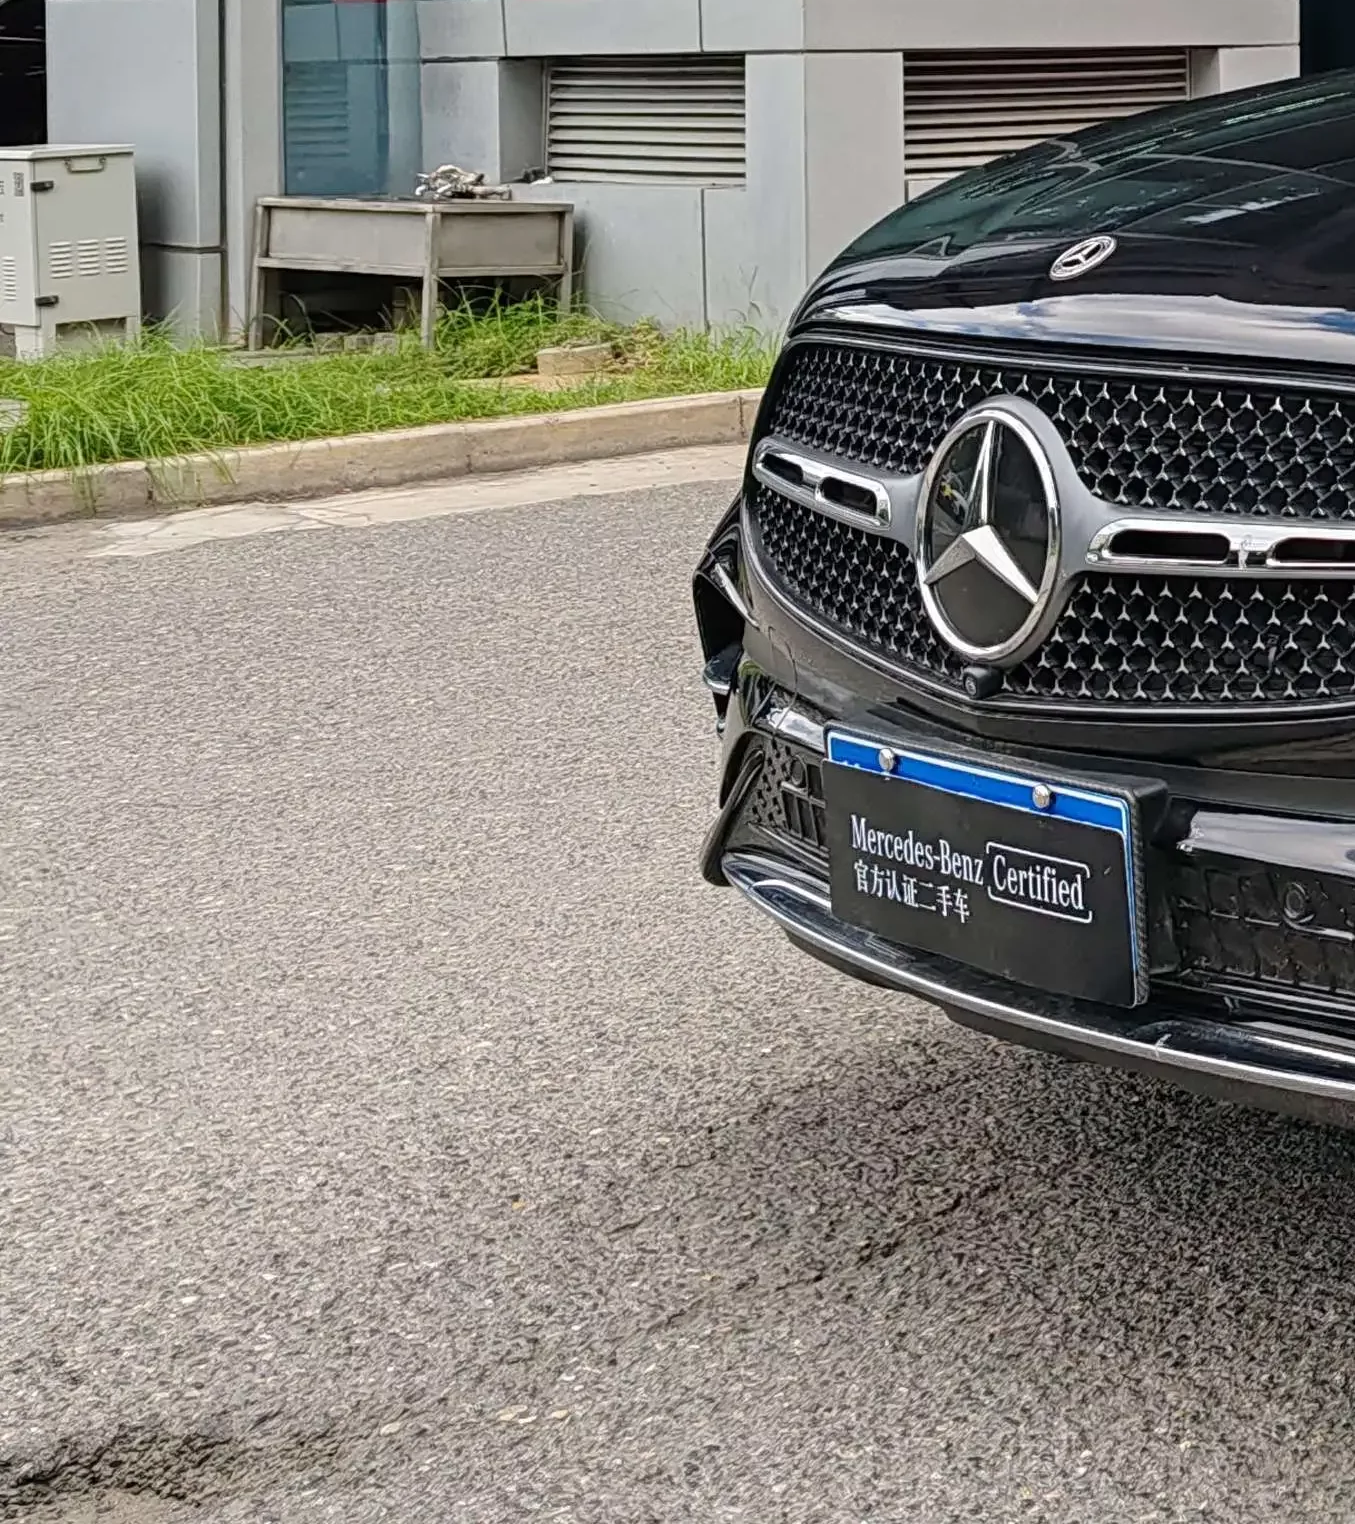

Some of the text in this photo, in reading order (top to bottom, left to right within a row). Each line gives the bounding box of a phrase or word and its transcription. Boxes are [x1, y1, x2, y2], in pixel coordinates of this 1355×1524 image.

[850, 814, 1085, 911] Mercedes-Benz Certified
[854, 859, 971, 923] 官方认证二手车
